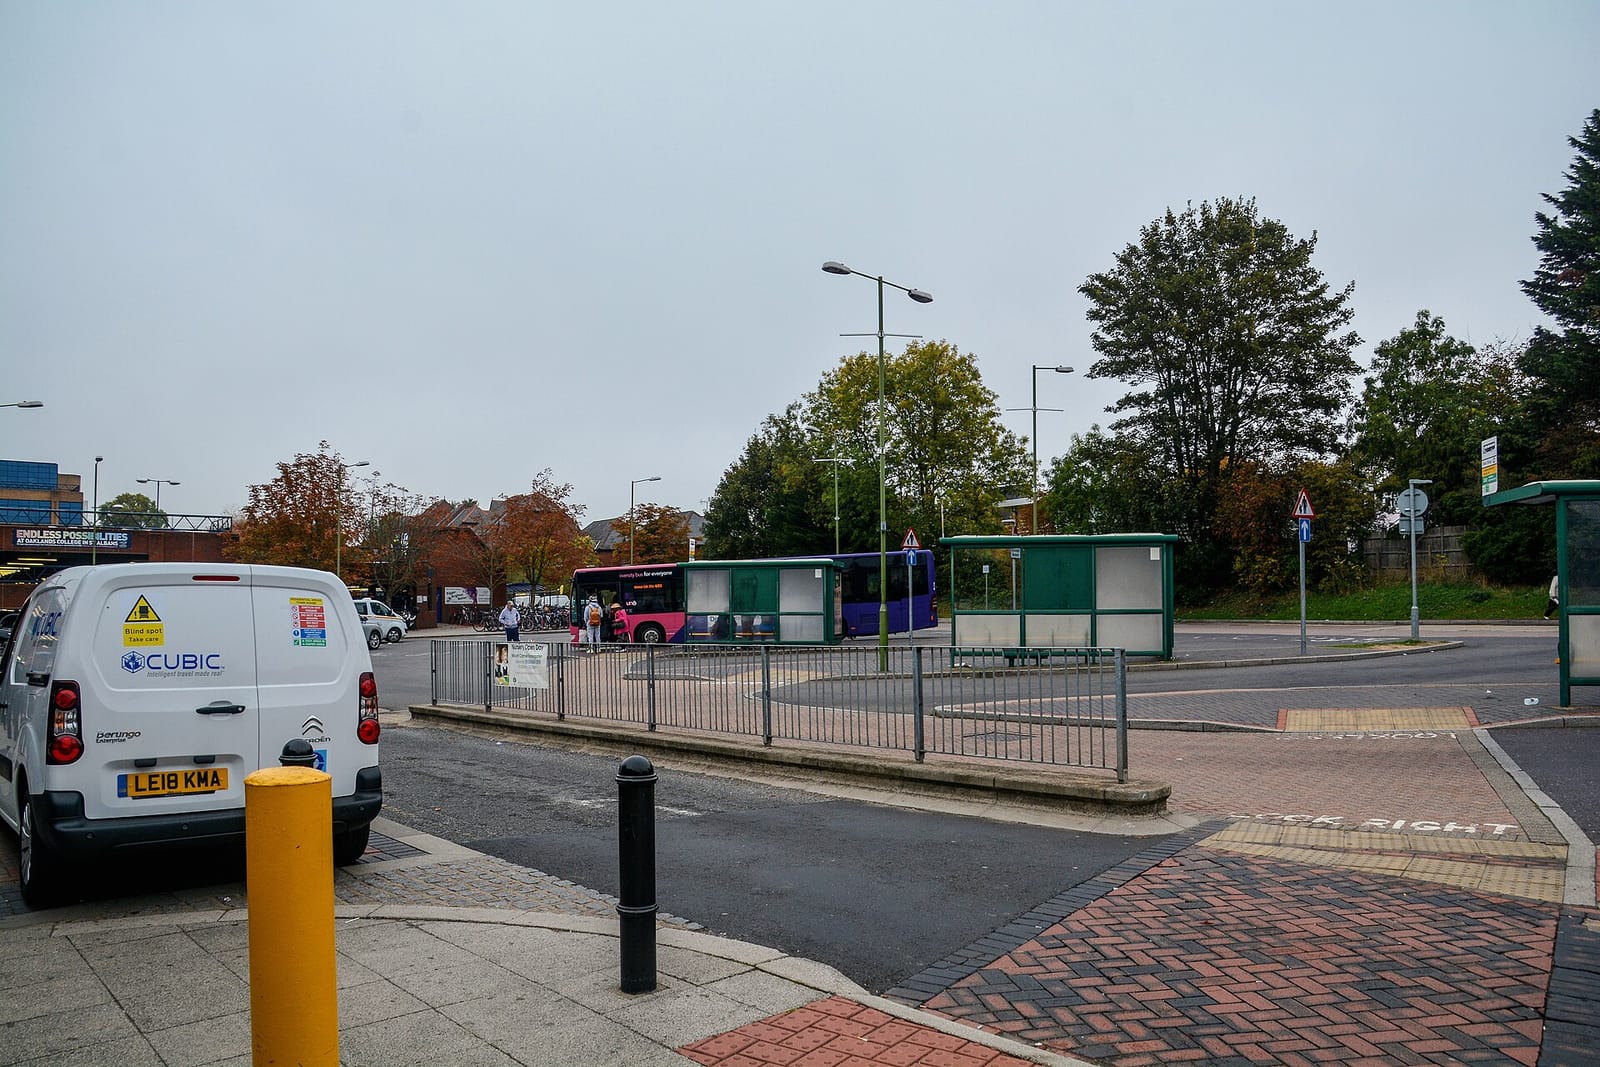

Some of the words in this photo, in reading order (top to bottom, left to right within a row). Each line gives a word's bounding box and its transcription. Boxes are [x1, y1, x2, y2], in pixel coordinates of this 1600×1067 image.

[16, 529, 61, 539] ENDLESS
[146, 654, 221, 670] CUBIC
[134, 773, 179, 792] LE18
[184, 770, 221, 789] KMA
[1229, 811, 1344, 825] LOOK
[1362, 818, 1519, 834] RIGHT
